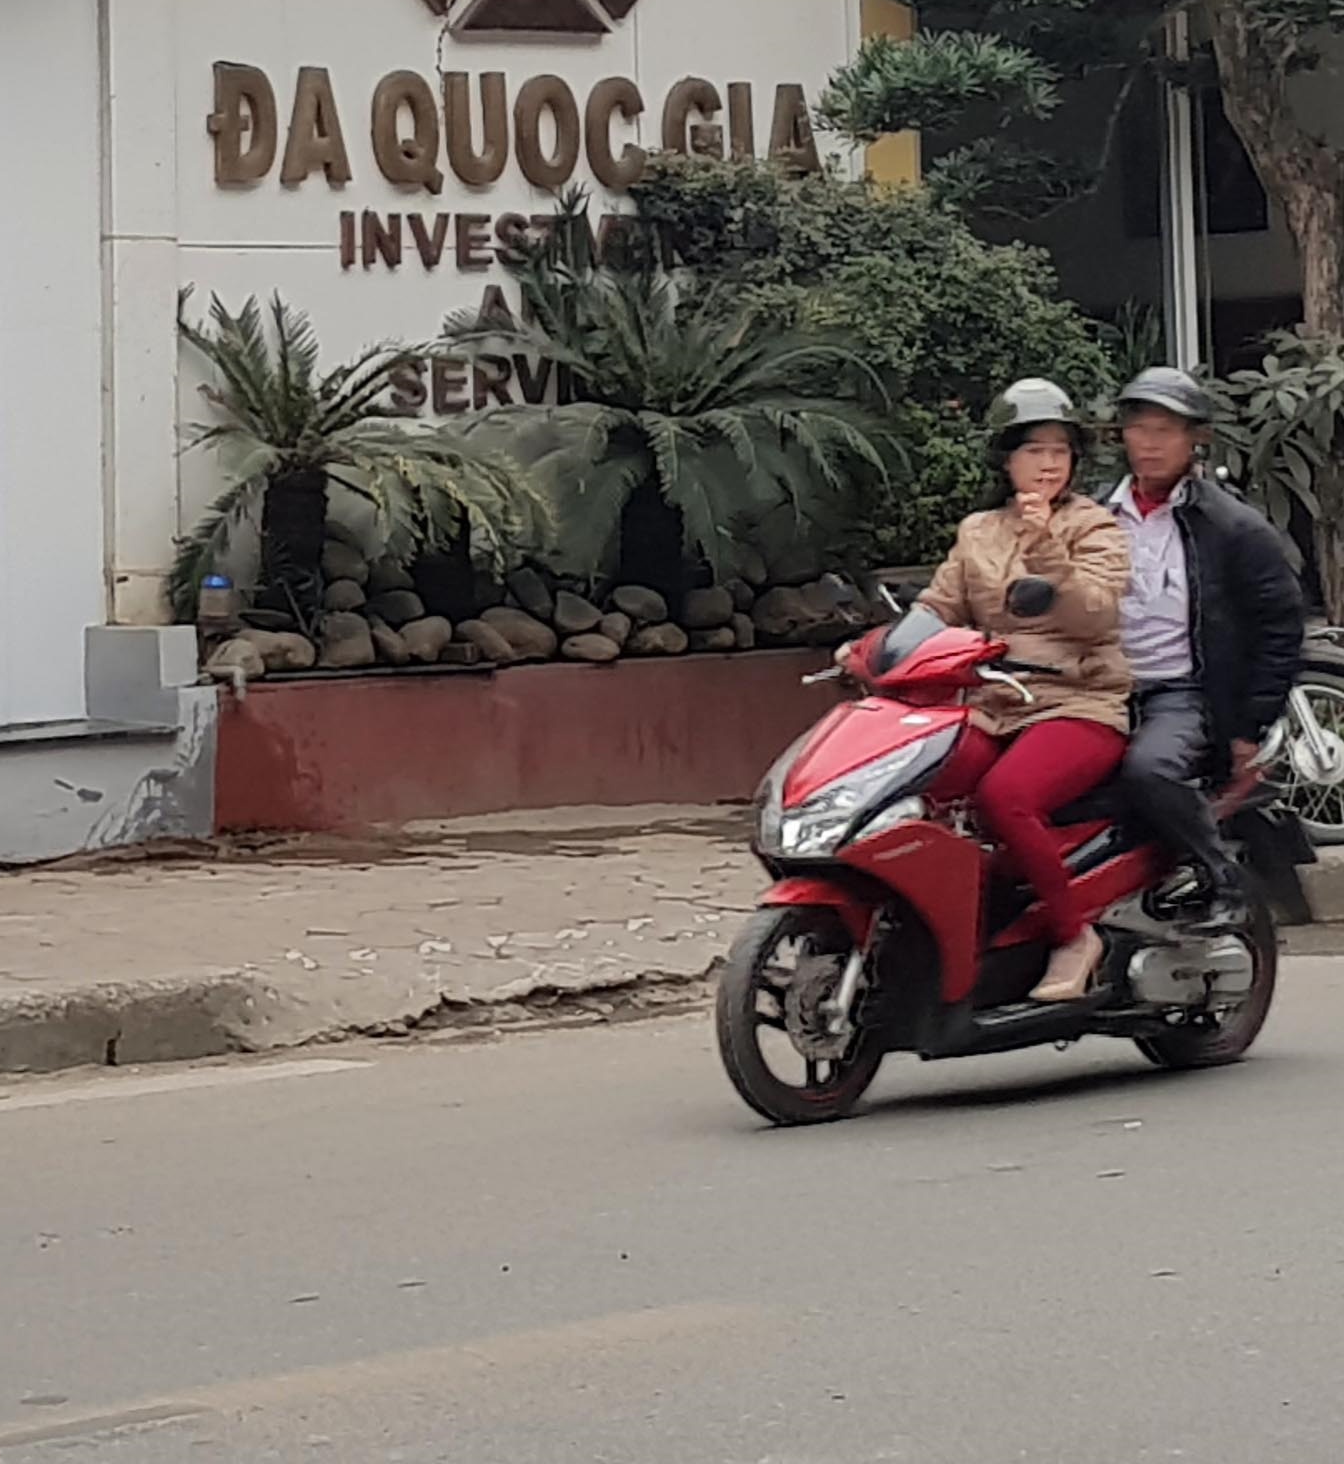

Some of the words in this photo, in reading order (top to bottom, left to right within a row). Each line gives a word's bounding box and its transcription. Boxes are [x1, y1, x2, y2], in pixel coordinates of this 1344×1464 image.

[207, 61, 352, 188] ĐA
[371, 69, 645, 195] QUOC
[661, 76, 826, 184] GIA
